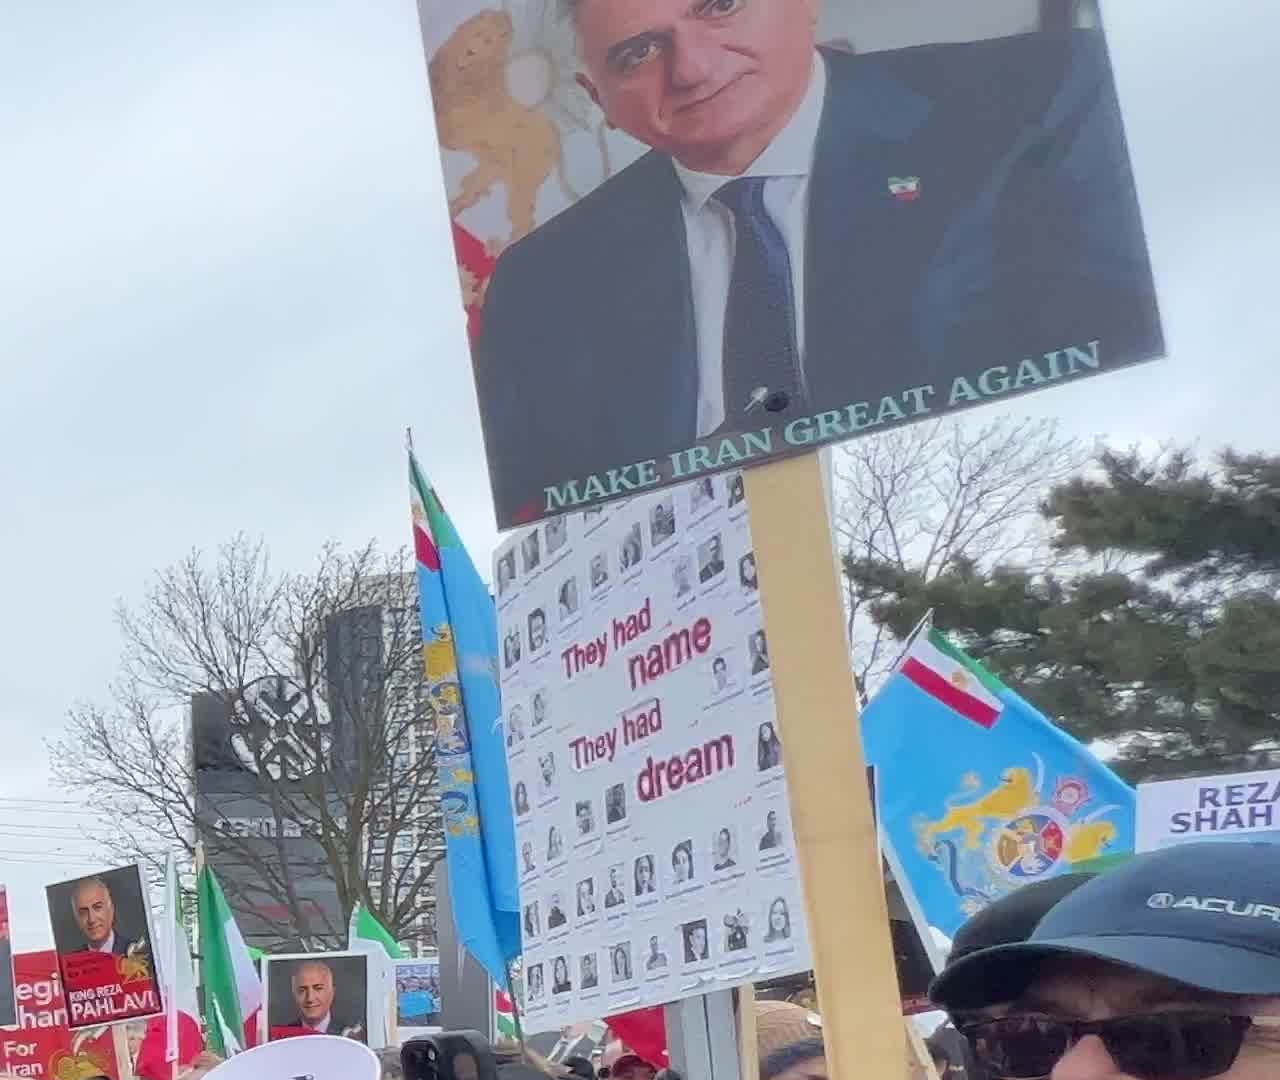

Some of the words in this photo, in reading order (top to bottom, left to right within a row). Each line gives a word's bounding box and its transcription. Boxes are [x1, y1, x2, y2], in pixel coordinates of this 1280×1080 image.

[542, 458, 662, 512] MAKE
[670, 427, 773, 478] IRAN
[783, 384, 937, 447] GREAT
[947, 340, 1101, 406] AGAIN
[561, 631, 608, 679] They
[613, 597, 652, 651] had
[627, 617, 712, 691] name
[569, 727, 617, 770] They
[622, 698, 663, 747] had
[636, 733, 736, 803] dream
[1170, 804, 1273, 834] SHAH
[15, 971, 61, 1006] egi
[69, 987, 95, 1002] KING
[96, 983, 124, 999] REZA
[70, 990, 156, 1022] PAHLAVI
[3, 1040, 38, 1058] For
[5, 1061, 44, 1078] Iran
